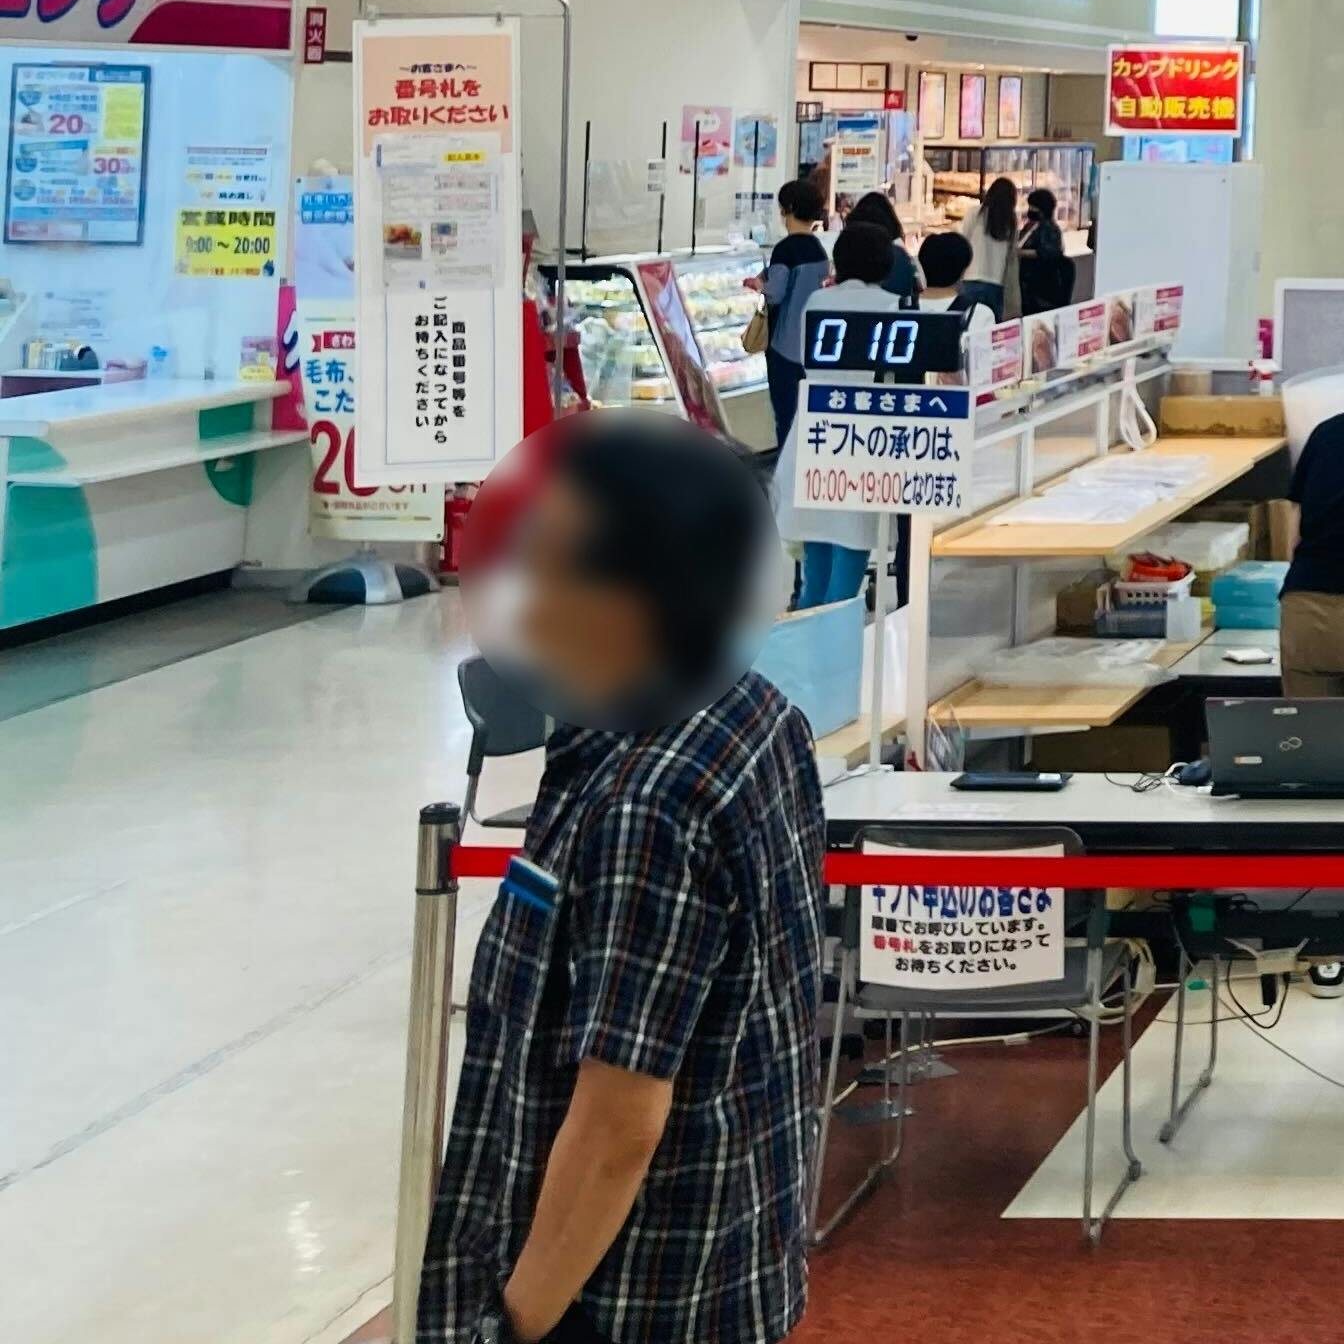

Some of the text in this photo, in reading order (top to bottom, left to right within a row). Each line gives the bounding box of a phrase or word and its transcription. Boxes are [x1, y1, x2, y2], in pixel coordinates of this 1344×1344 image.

[1113, 57, 1240, 81] カップドリンク
[394, 78, 482, 100] 番号札を
[367, 105, 510, 126] お取りください
[1117, 96, 1235, 120] 自動販売機
[305, 359, 353, 384] 毛布、
[414, 314, 430, 429] お待ちください
[433, 295, 449, 445] ご記入になってから
[828, 389, 948, 413] お客さまへ
[807, 419, 961, 463] ギフトの承りは、
[871, 915, 1046, 937] 順番でお呼びしています。
[873, 934, 1052, 955] 番号札をお取りになって
[895, 958, 1017, 974] お待ちください。
